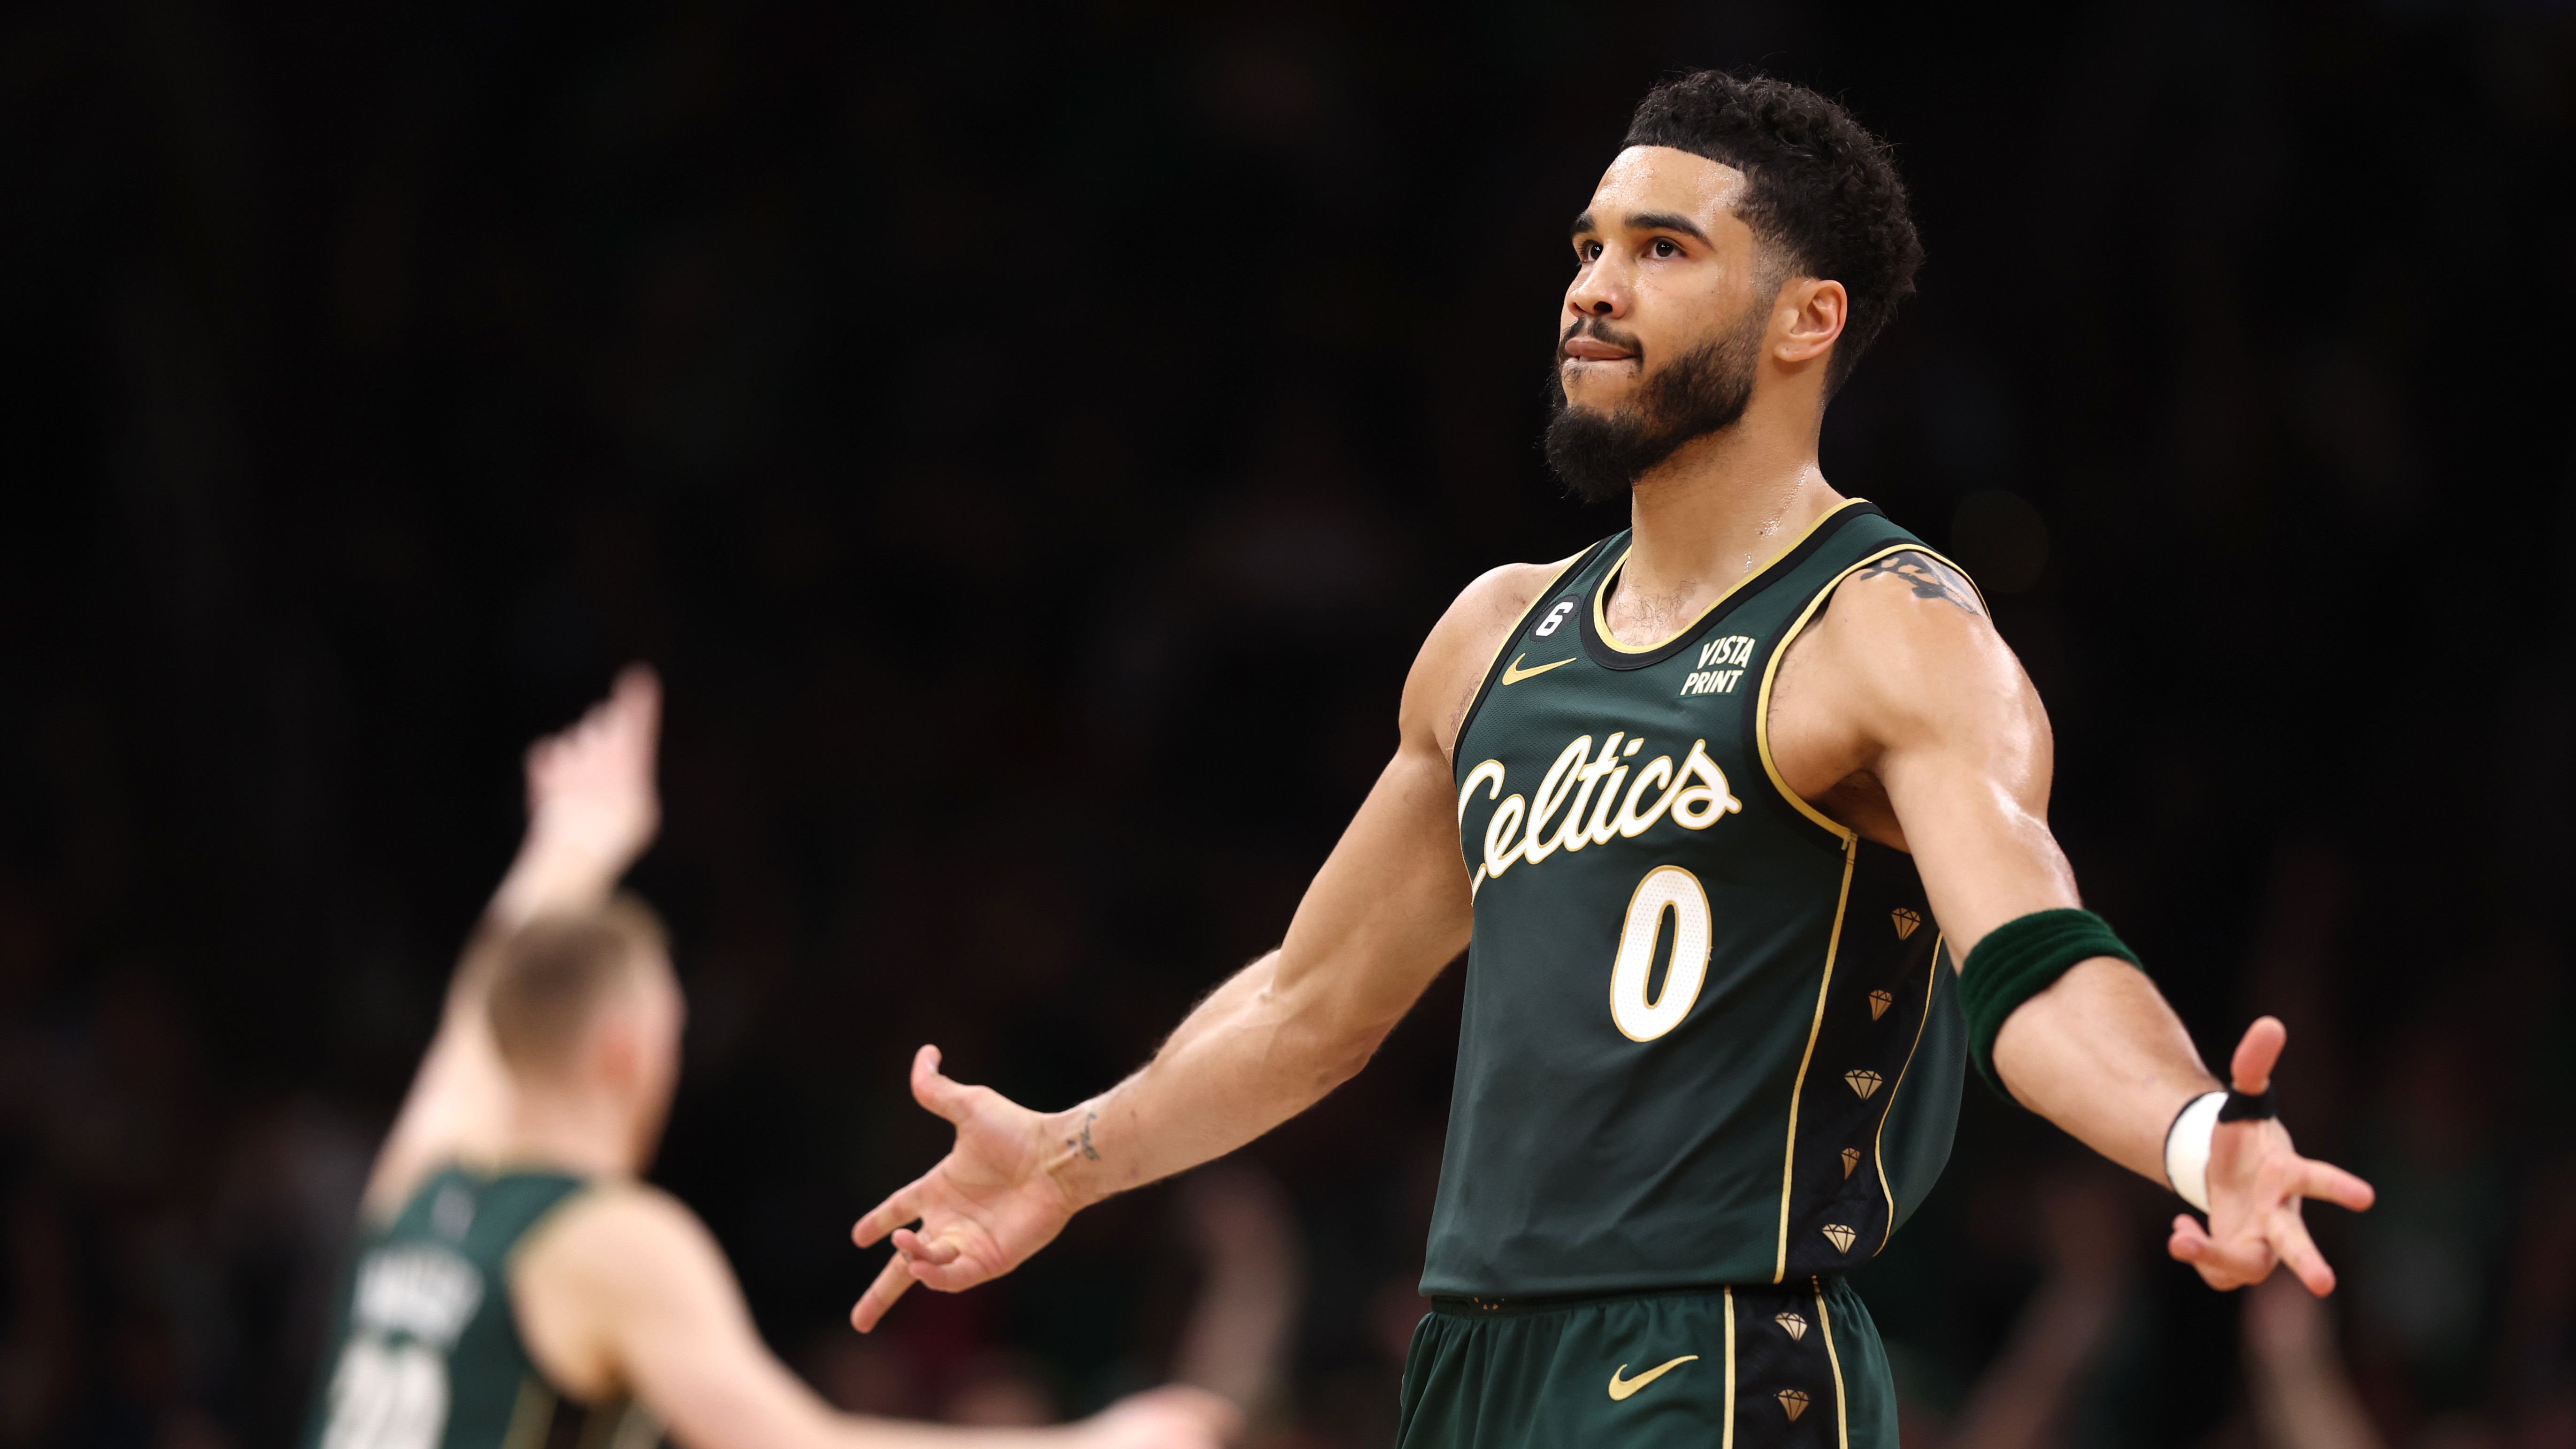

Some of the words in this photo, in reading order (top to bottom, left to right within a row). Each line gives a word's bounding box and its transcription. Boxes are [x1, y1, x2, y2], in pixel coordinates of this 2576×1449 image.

[1536, 602, 1573, 636] 6
[1697, 635, 1756, 670] VISTA
[1680, 670, 1744, 695] PRINT
[1458, 732, 1742, 907] Celtics
[1610, 865, 1712, 1043] 0
